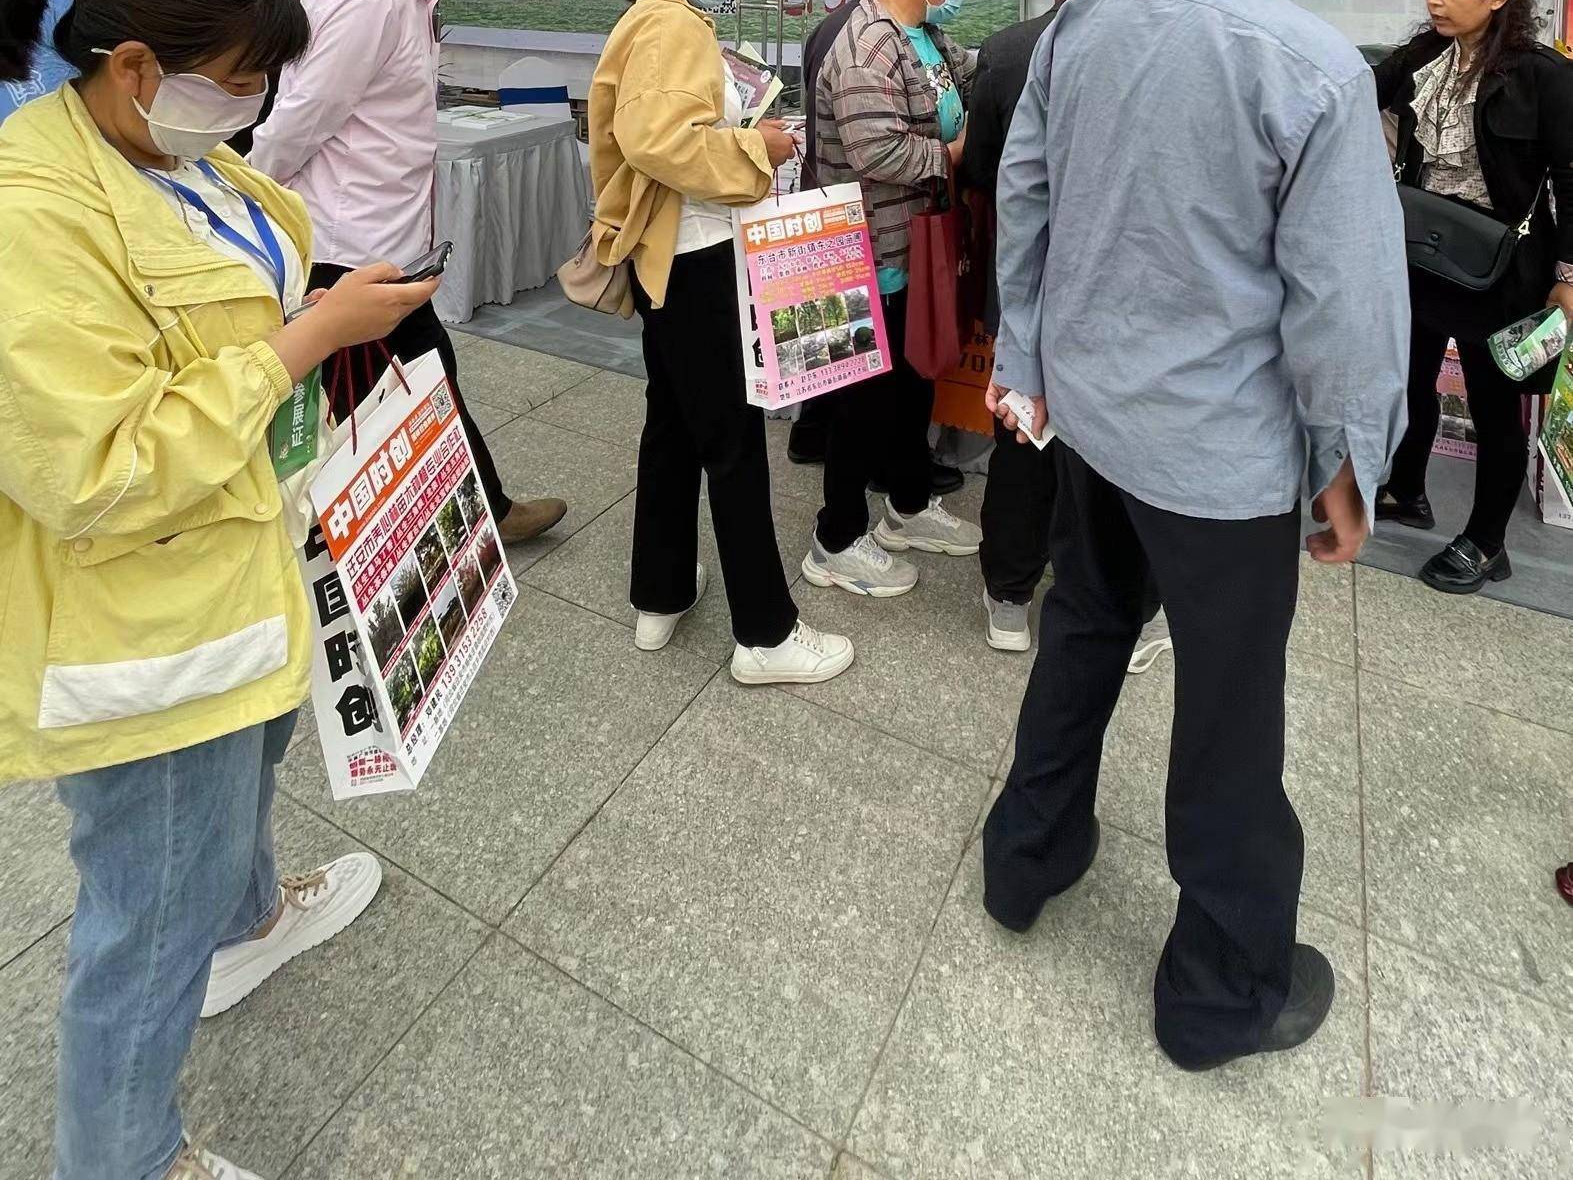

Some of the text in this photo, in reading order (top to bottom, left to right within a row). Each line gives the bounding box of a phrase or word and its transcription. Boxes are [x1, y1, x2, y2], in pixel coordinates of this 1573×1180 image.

[747, 211, 823, 245] 中国时创
[291, 382, 306, 449] 参展证
[327, 425, 414, 540] 中国时创
[441, 663, 456, 690] 139
[455, 634, 473, 667] 3153
[469, 607, 489, 640] 2258
